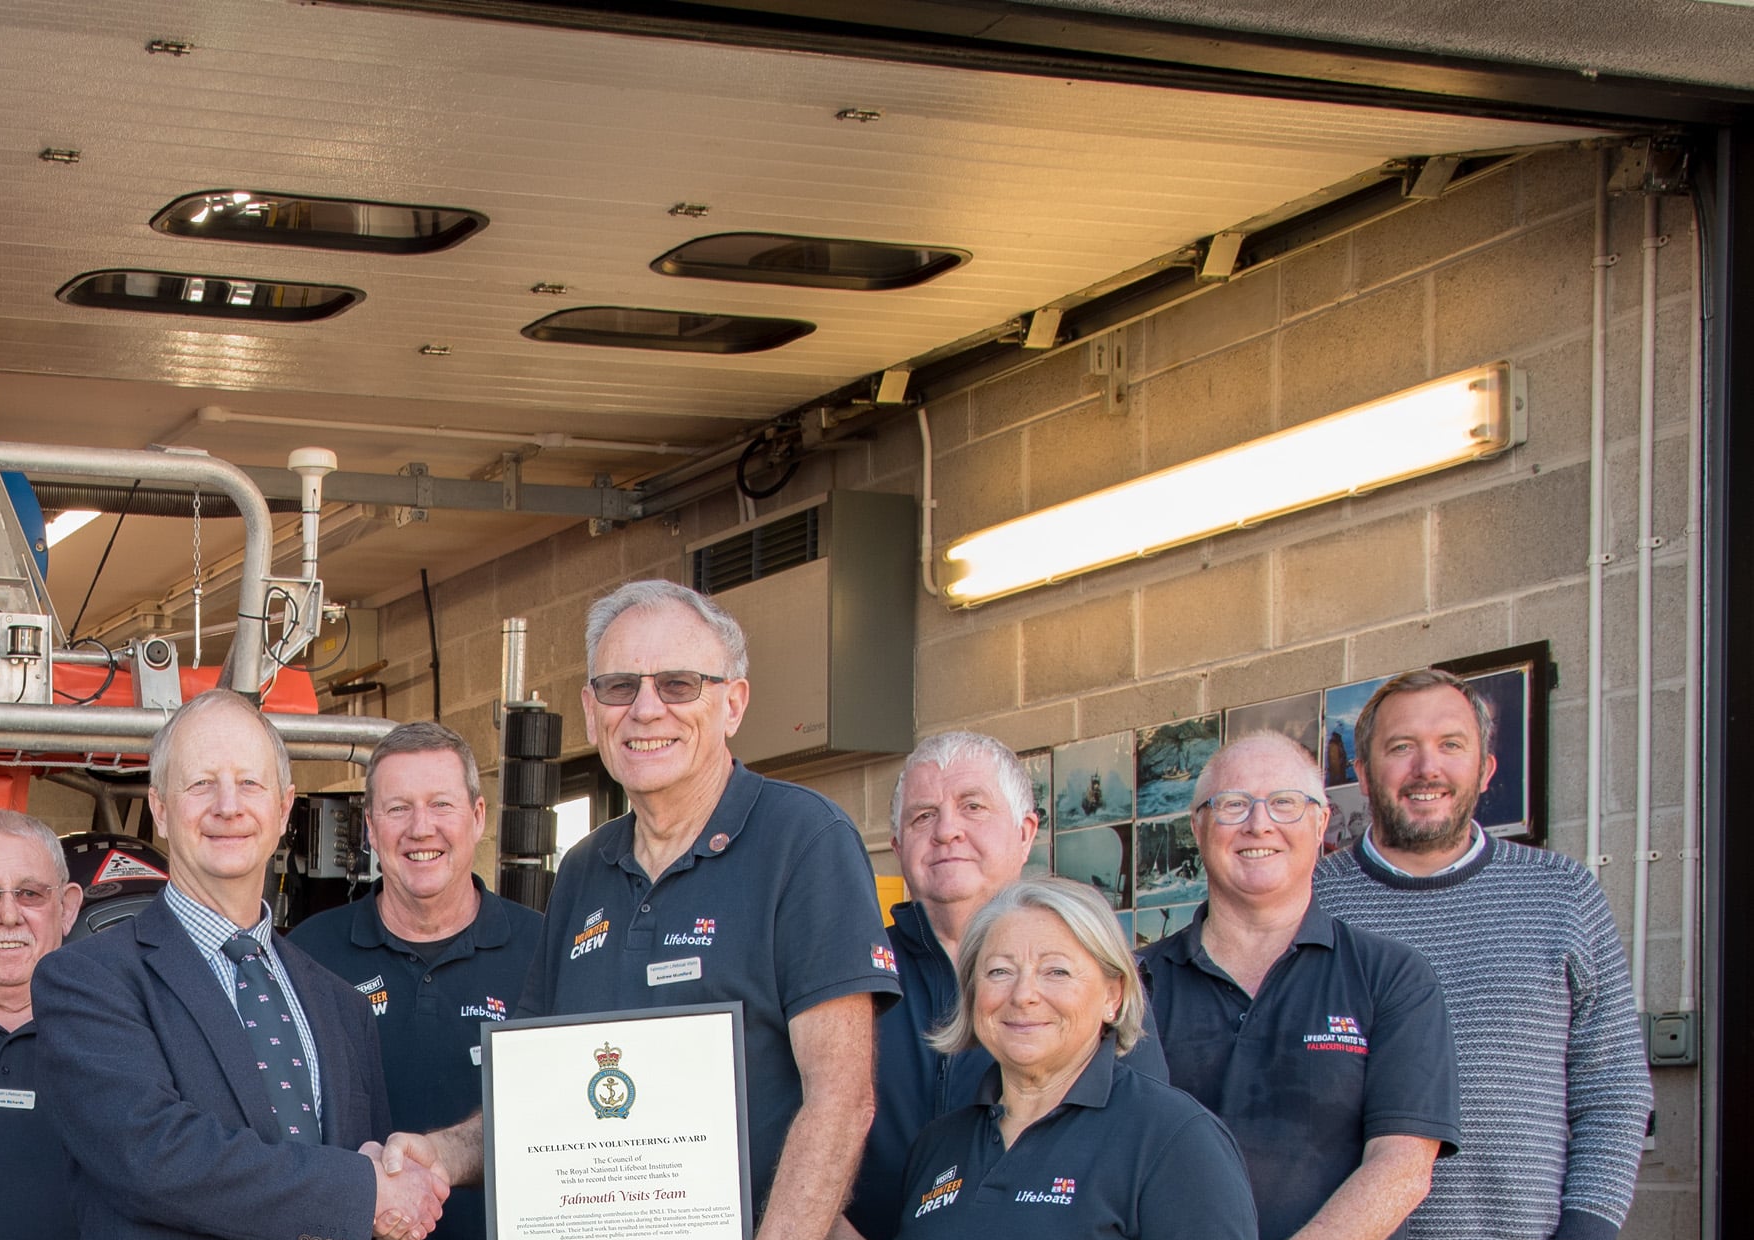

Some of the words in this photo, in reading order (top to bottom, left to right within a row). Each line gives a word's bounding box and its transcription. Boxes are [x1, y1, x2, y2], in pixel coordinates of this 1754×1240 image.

[586, 912, 602, 926] VISITS
[570, 932, 608, 960] CREW
[664, 934, 712, 946] Lifeboats
[460, 1006, 506, 1022] Lifeboats
[1303, 1034, 1336, 1042] LIFEBOAT
[1337, 1035, 1358, 1045] VISITS
[1306, 1042, 1344, 1051] FALMOUTH
[528, 1142, 586, 1153] EXCELLENCE
[599, 1137, 670, 1147] VOLUNTEERING
[672, 1134, 707, 1144] AWARD
[607, 1156, 633, 1164] Council
[634, 1154, 642, 1162] of
[570, 1168, 588, 1176] Royal
[590, 1166, 618, 1174] National
[620, 1164, 647, 1172] Lifeboat
[648, 1162, 683, 1170] Institution
[560, 1177, 577, 1185] wish
[586, 1175, 606, 1183] record
[648, 1172, 670, 1180] thanks
[936, 1170, 954, 1185] VISITS
[559, 1190, 615, 1208] Falmouth
[618, 1190, 650, 1202] Visits
[652, 1188, 686, 1200] Team
[921, 1178, 963, 1204] VOLUNTEER
[1015, 1191, 1073, 1205] Lifeboats
[915, 1190, 958, 1218] CREW
